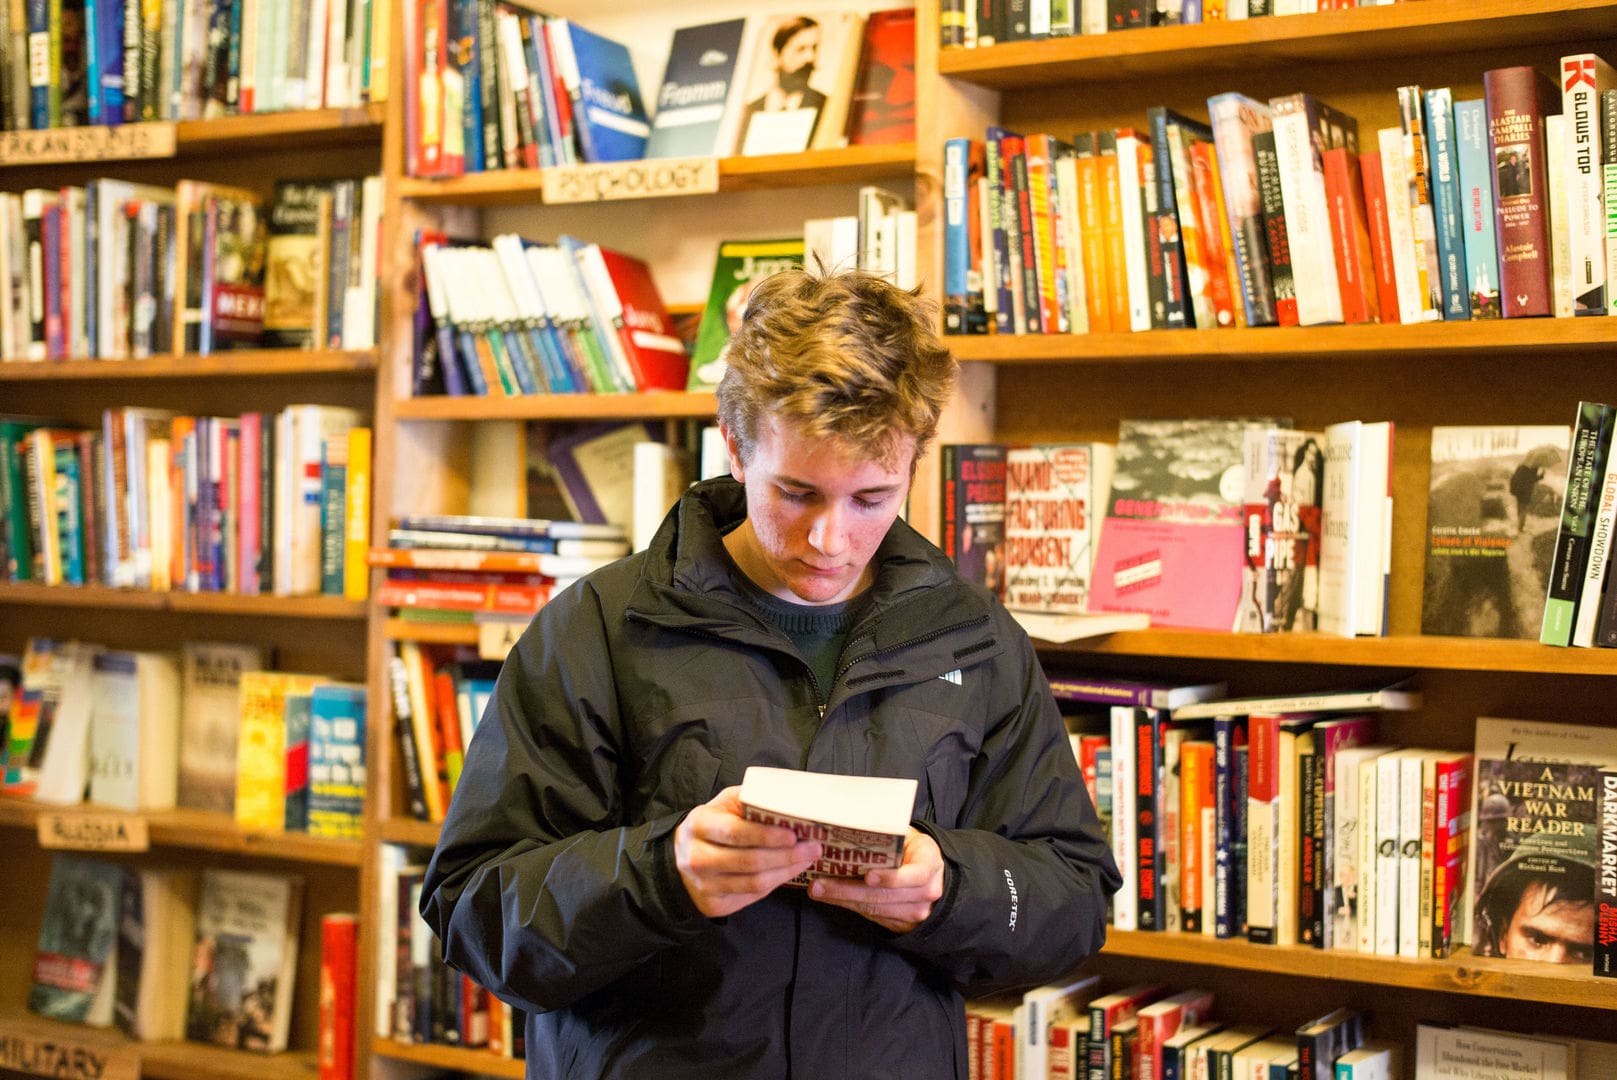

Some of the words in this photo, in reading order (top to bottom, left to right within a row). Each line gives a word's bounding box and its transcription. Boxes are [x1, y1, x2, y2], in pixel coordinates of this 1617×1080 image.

[1564, 60, 1595, 93] K
[1490, 115, 1532, 128] ALASTAIR
[1575, 92, 1590, 144] BLOWS
[1489, 123, 1534, 137] CAMPBELL
[1493, 132, 1531, 144] DIARIES
[1577, 147, 1590, 175] TOP
[1526, 203, 1539, 211] TO
[1501, 250, 1538, 262] Campbell
[1504, 242, 1534, 253] Alastair
[1588, 431, 1598, 449] THE
[1573, 428, 1590, 477] EUROPEAN
[1583, 449, 1596, 477] STATE
[1569, 477, 1583, 509] UNION
[1581, 478, 1591, 489] OF
[1602, 473, 1617, 514] GLOBAL
[1578, 491, 1589, 510] THE
[1462, 536, 1471, 547] of
[1474, 536, 1513, 548] Violence
[1589, 517, 1610, 580] SHOWDOWN
[1540, 766, 1554, 782] A
[1498, 780, 1594, 802] VIETNAM
[1524, 801, 1567, 818] WAR
[1506, 816, 1585, 837] READER
[1602, 776, 1617, 897] DARKMARKET
[1303, 836, 1314, 883] ANGLER
[1598, 903, 1610, 946] GLENNY
[1607, 907, 1617, 943] MISHA
